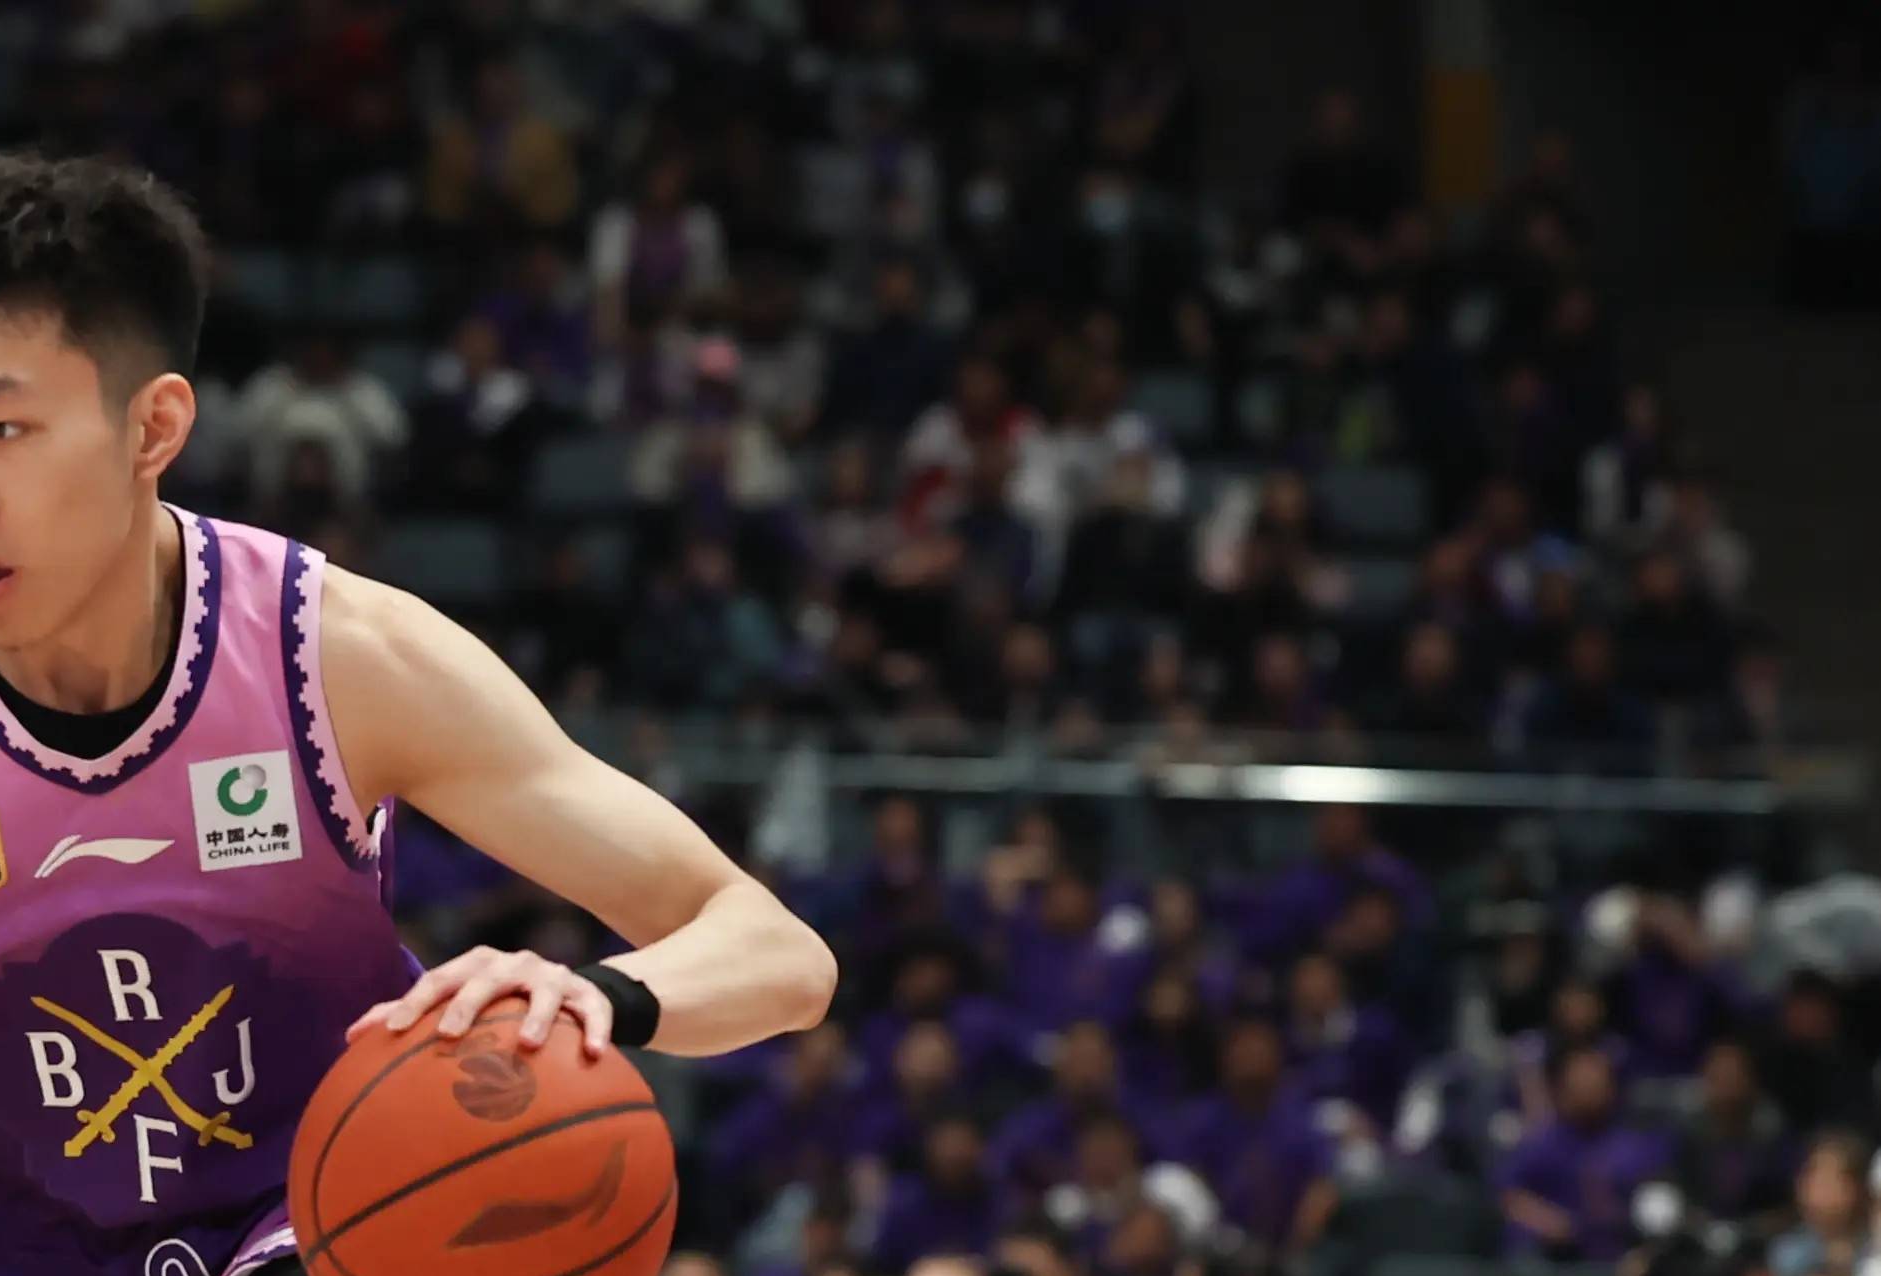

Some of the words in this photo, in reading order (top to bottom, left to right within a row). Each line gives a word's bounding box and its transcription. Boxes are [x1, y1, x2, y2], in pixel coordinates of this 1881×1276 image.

[206, 823, 289, 847] 中国人寿
[208, 846, 254, 860] CHINA
[259, 841, 290, 853] LIFE
[97, 949, 163, 1021] R
[24, 1031, 85, 1107] B
[212, 1016, 256, 1105] J
[133, 1113, 183, 1203] F
